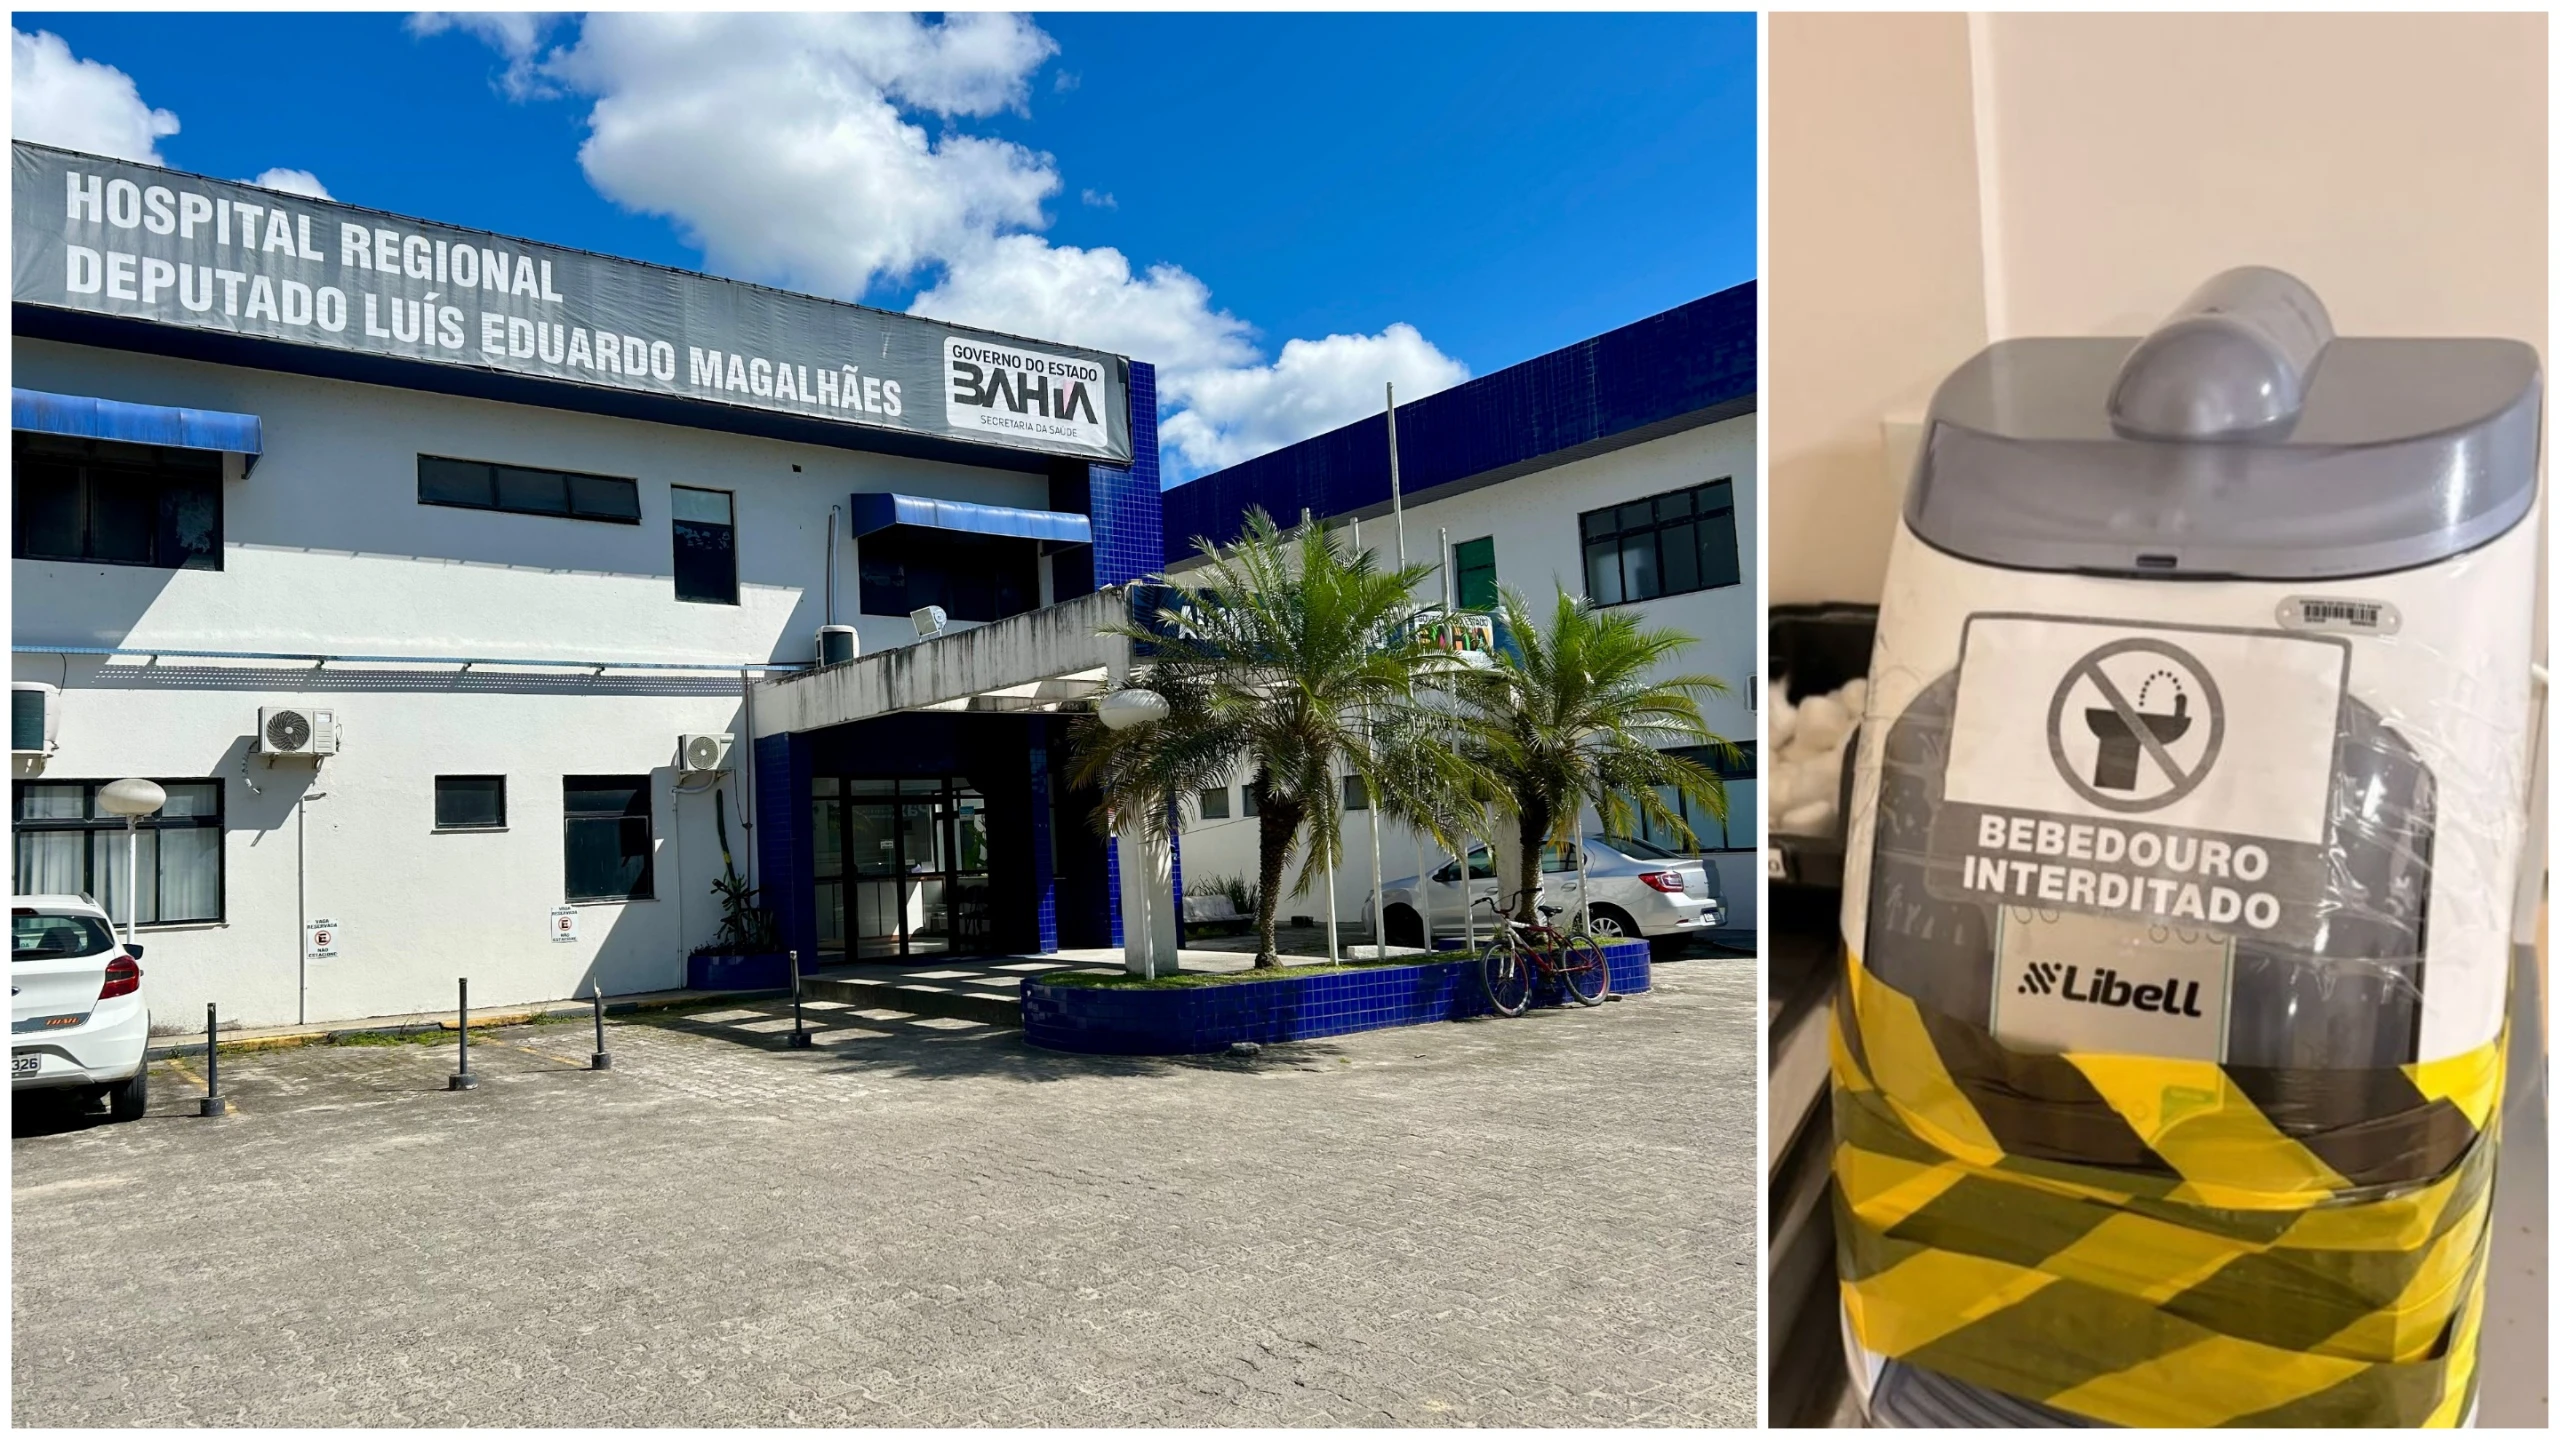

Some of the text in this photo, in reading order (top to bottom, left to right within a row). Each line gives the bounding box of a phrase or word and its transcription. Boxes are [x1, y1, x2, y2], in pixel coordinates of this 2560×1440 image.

[66, 170, 563, 303] HOSPITAL REGIONAL
[66, 244, 902, 417] DEPUTADO LUÍS EDUARDO MAGALHÃES
[952, 344, 1097, 382] GOVERNO DO ESTADO
[952, 360, 1099, 425] BAHIA
[980, 414, 1078, 437] SECRETARIA DA SAÚDE
[1978, 814, 2269, 881] BEBEDOURO
[1963, 855, 2280, 929] INTERDITADO
[318, 933, 327, 943] E
[561, 919, 569, 928] E
[2060, 963, 2203, 1018] Libell
